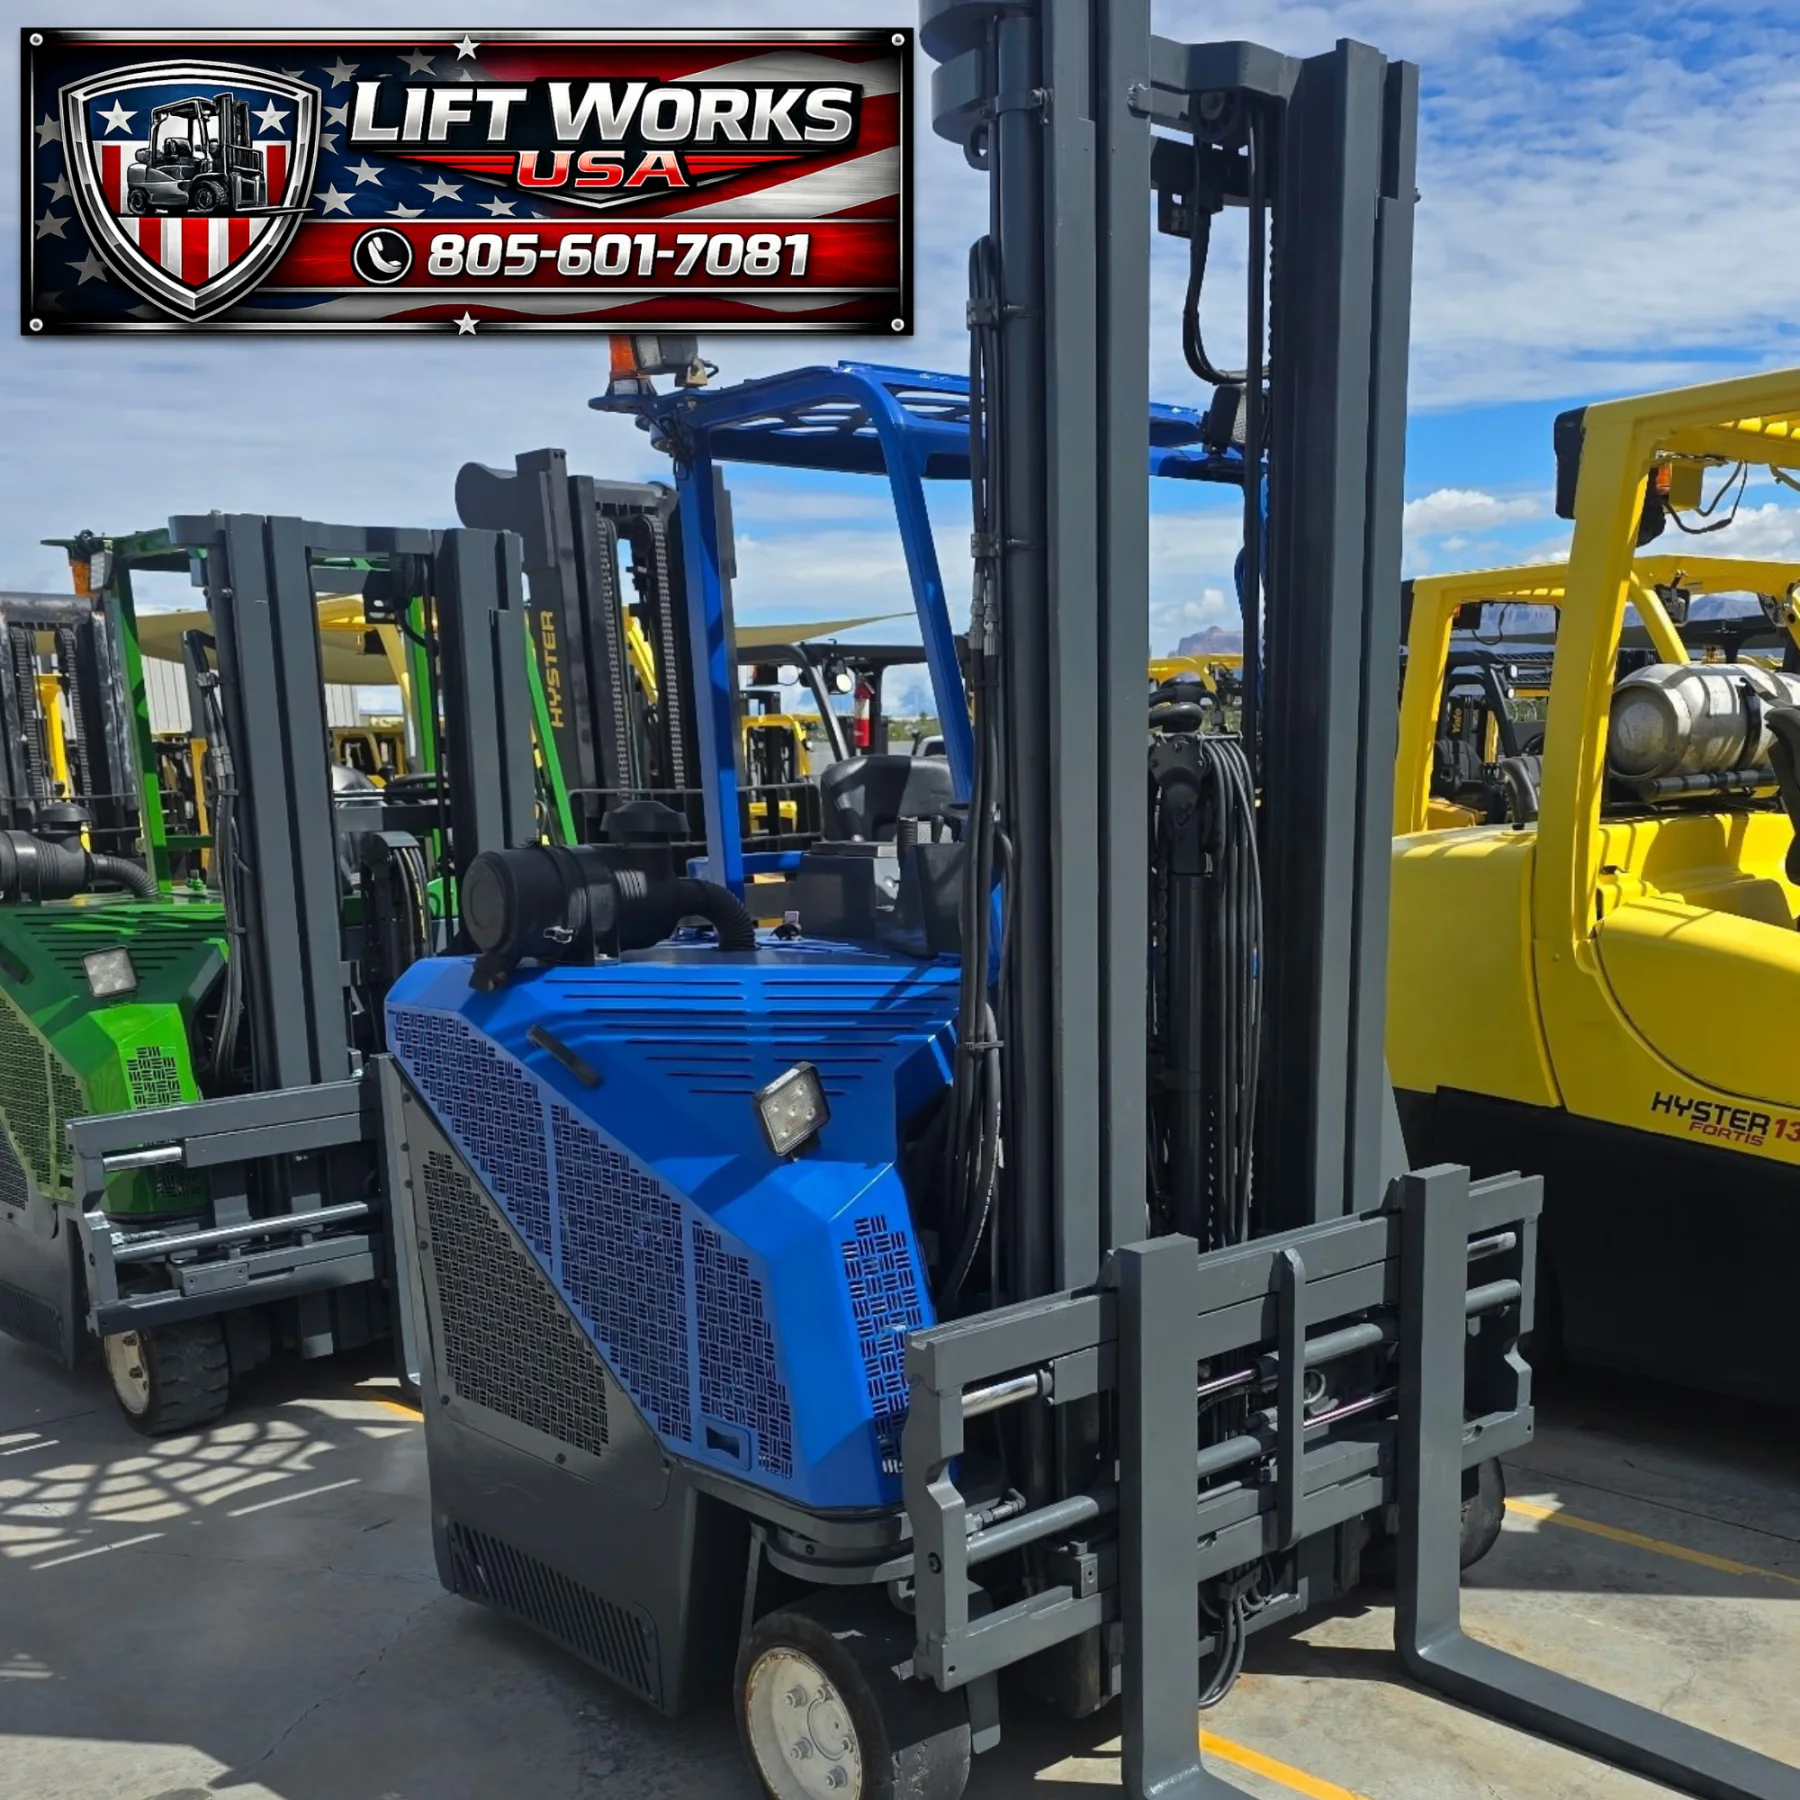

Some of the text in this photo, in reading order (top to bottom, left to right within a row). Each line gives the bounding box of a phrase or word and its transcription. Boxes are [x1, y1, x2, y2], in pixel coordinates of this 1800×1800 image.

[540, 610, 564, 728] HYSTER
[1651, 1091, 1771, 1135] HYSTER
[1689, 1121, 1765, 1147] FORTIS
